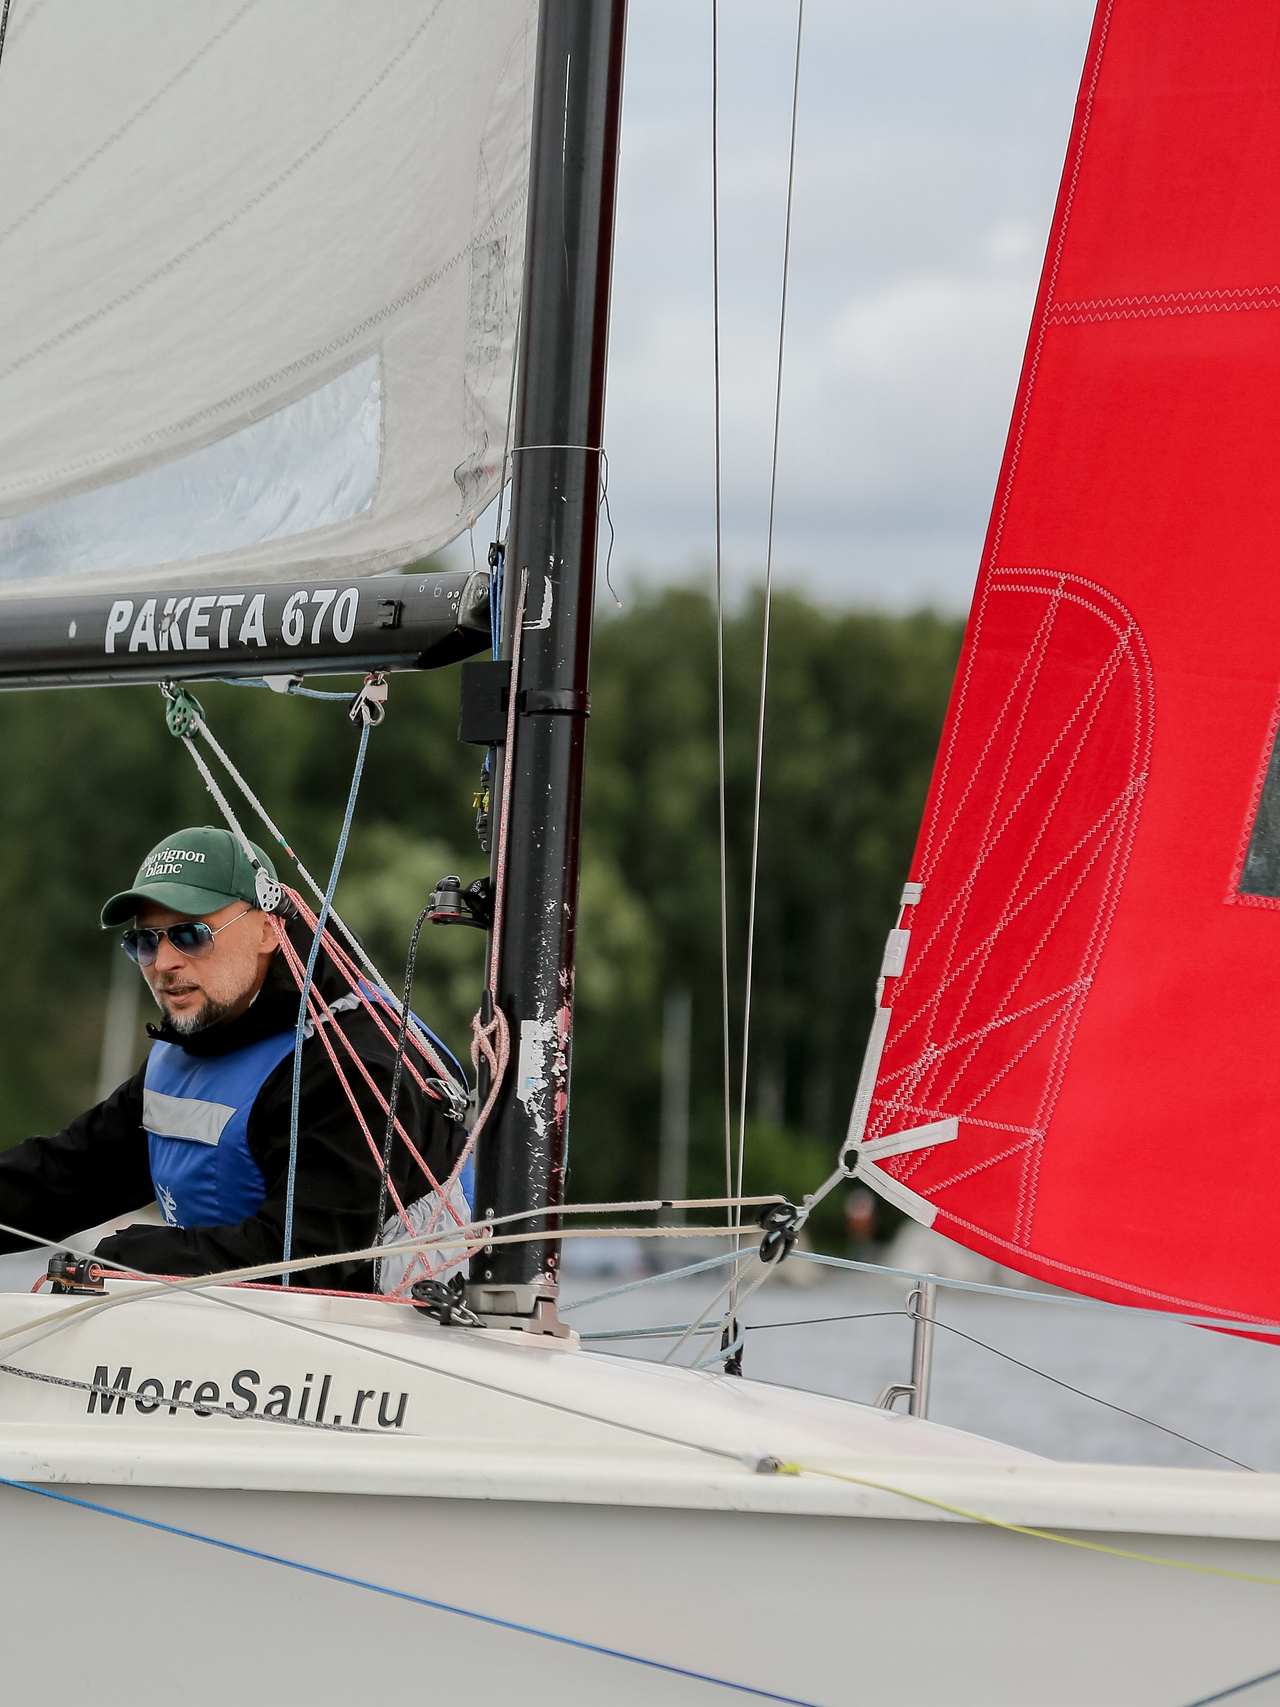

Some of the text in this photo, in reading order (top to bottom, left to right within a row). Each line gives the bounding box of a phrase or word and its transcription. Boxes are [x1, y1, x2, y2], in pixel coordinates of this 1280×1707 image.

[281, 587, 360, 646] 670
[145, 861, 183, 878] blanc
[86, 1365, 409, 1428] MoreSail.ru
